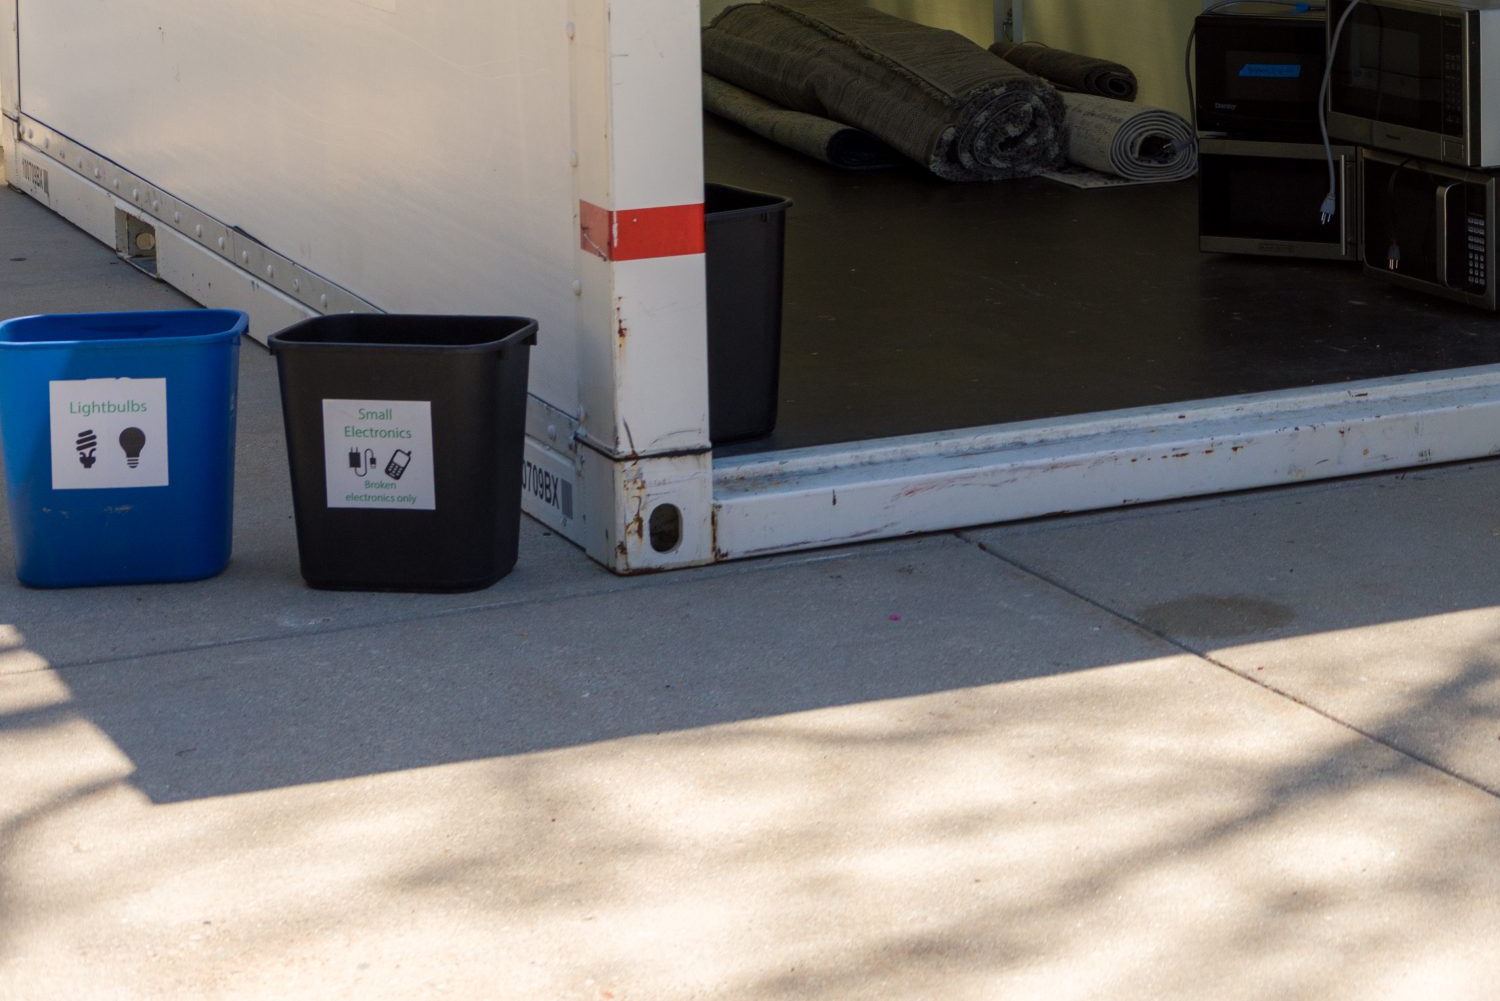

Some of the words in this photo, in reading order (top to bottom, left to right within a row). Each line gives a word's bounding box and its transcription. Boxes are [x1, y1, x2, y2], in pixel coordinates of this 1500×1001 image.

[70, 400, 147, 417] Lightbulbs
[358, 408, 392, 420] Small
[344, 426, 412, 439] Electronics
[364, 480, 397, 489] Broken
[345, 493, 395, 503] electronics
[397, 494, 416, 504] only
